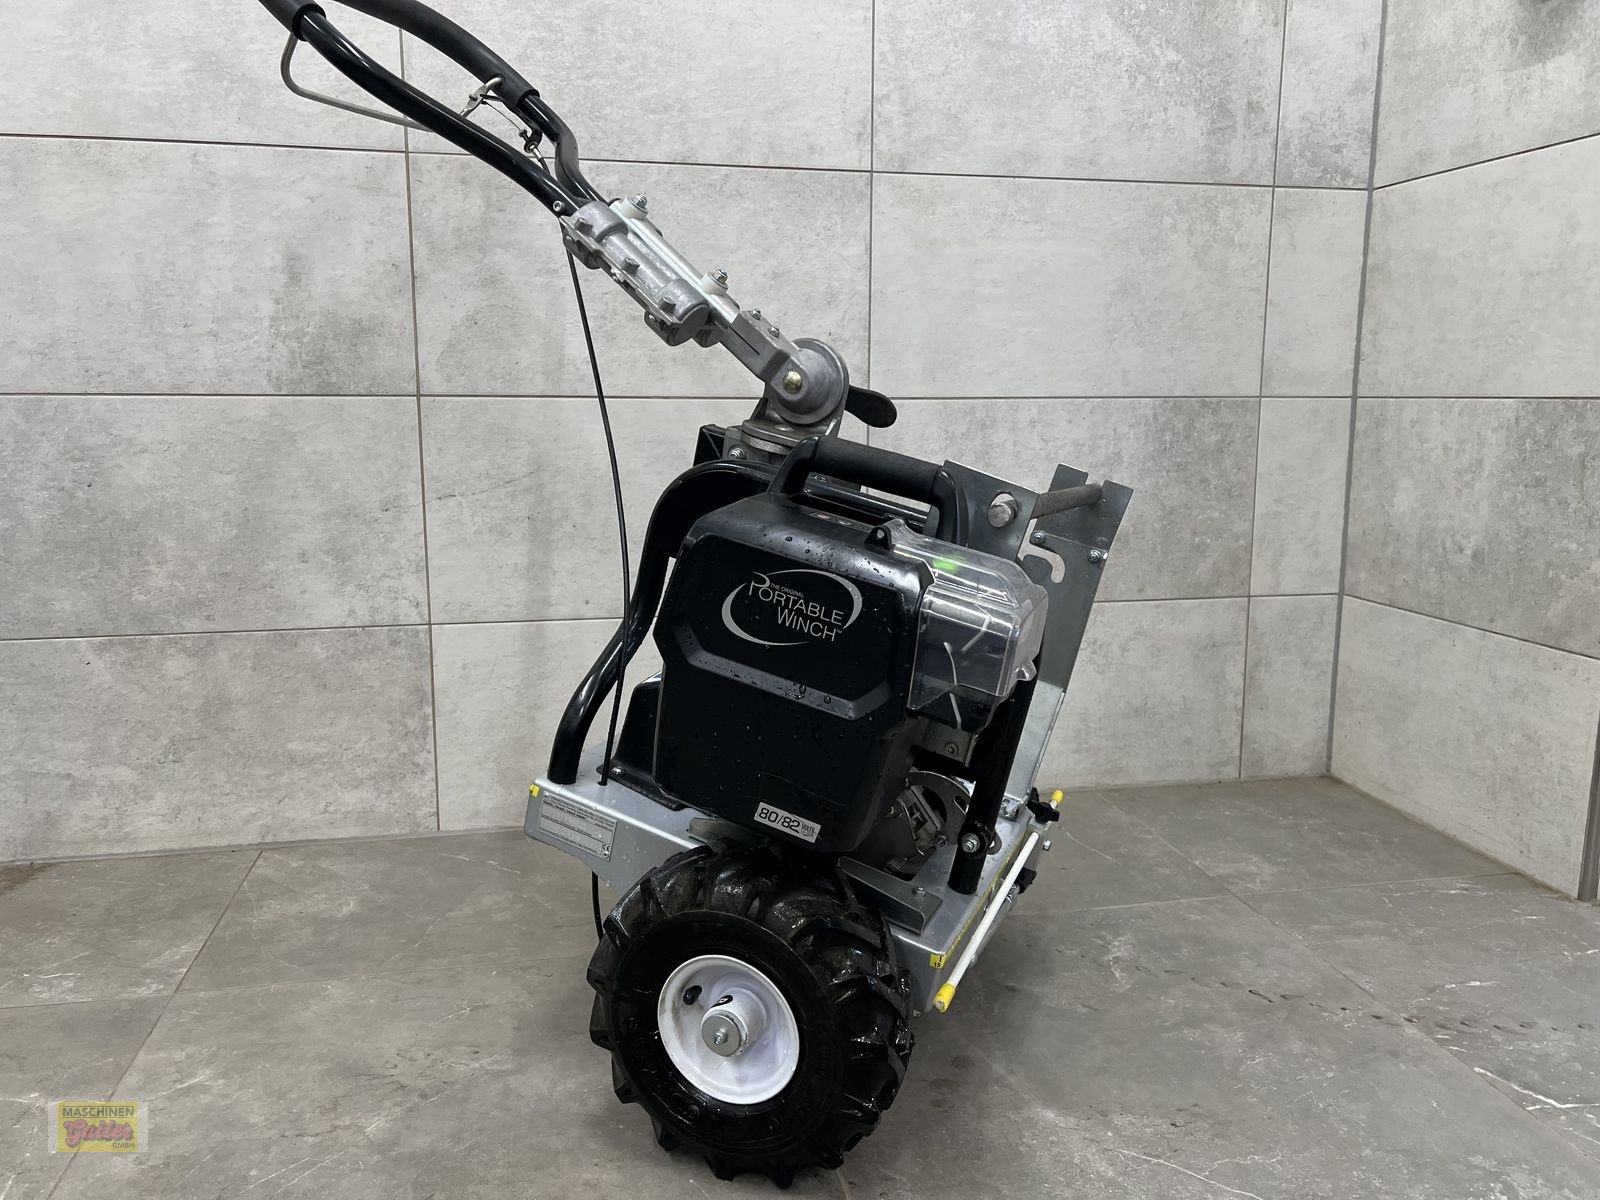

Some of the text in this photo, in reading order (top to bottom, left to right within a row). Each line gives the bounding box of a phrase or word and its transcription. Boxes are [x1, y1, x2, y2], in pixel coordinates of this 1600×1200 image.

[749, 571, 844, 626] PORTABLE
[778, 606, 836, 642] WINCH
[758, 807, 800, 834] 80/82
